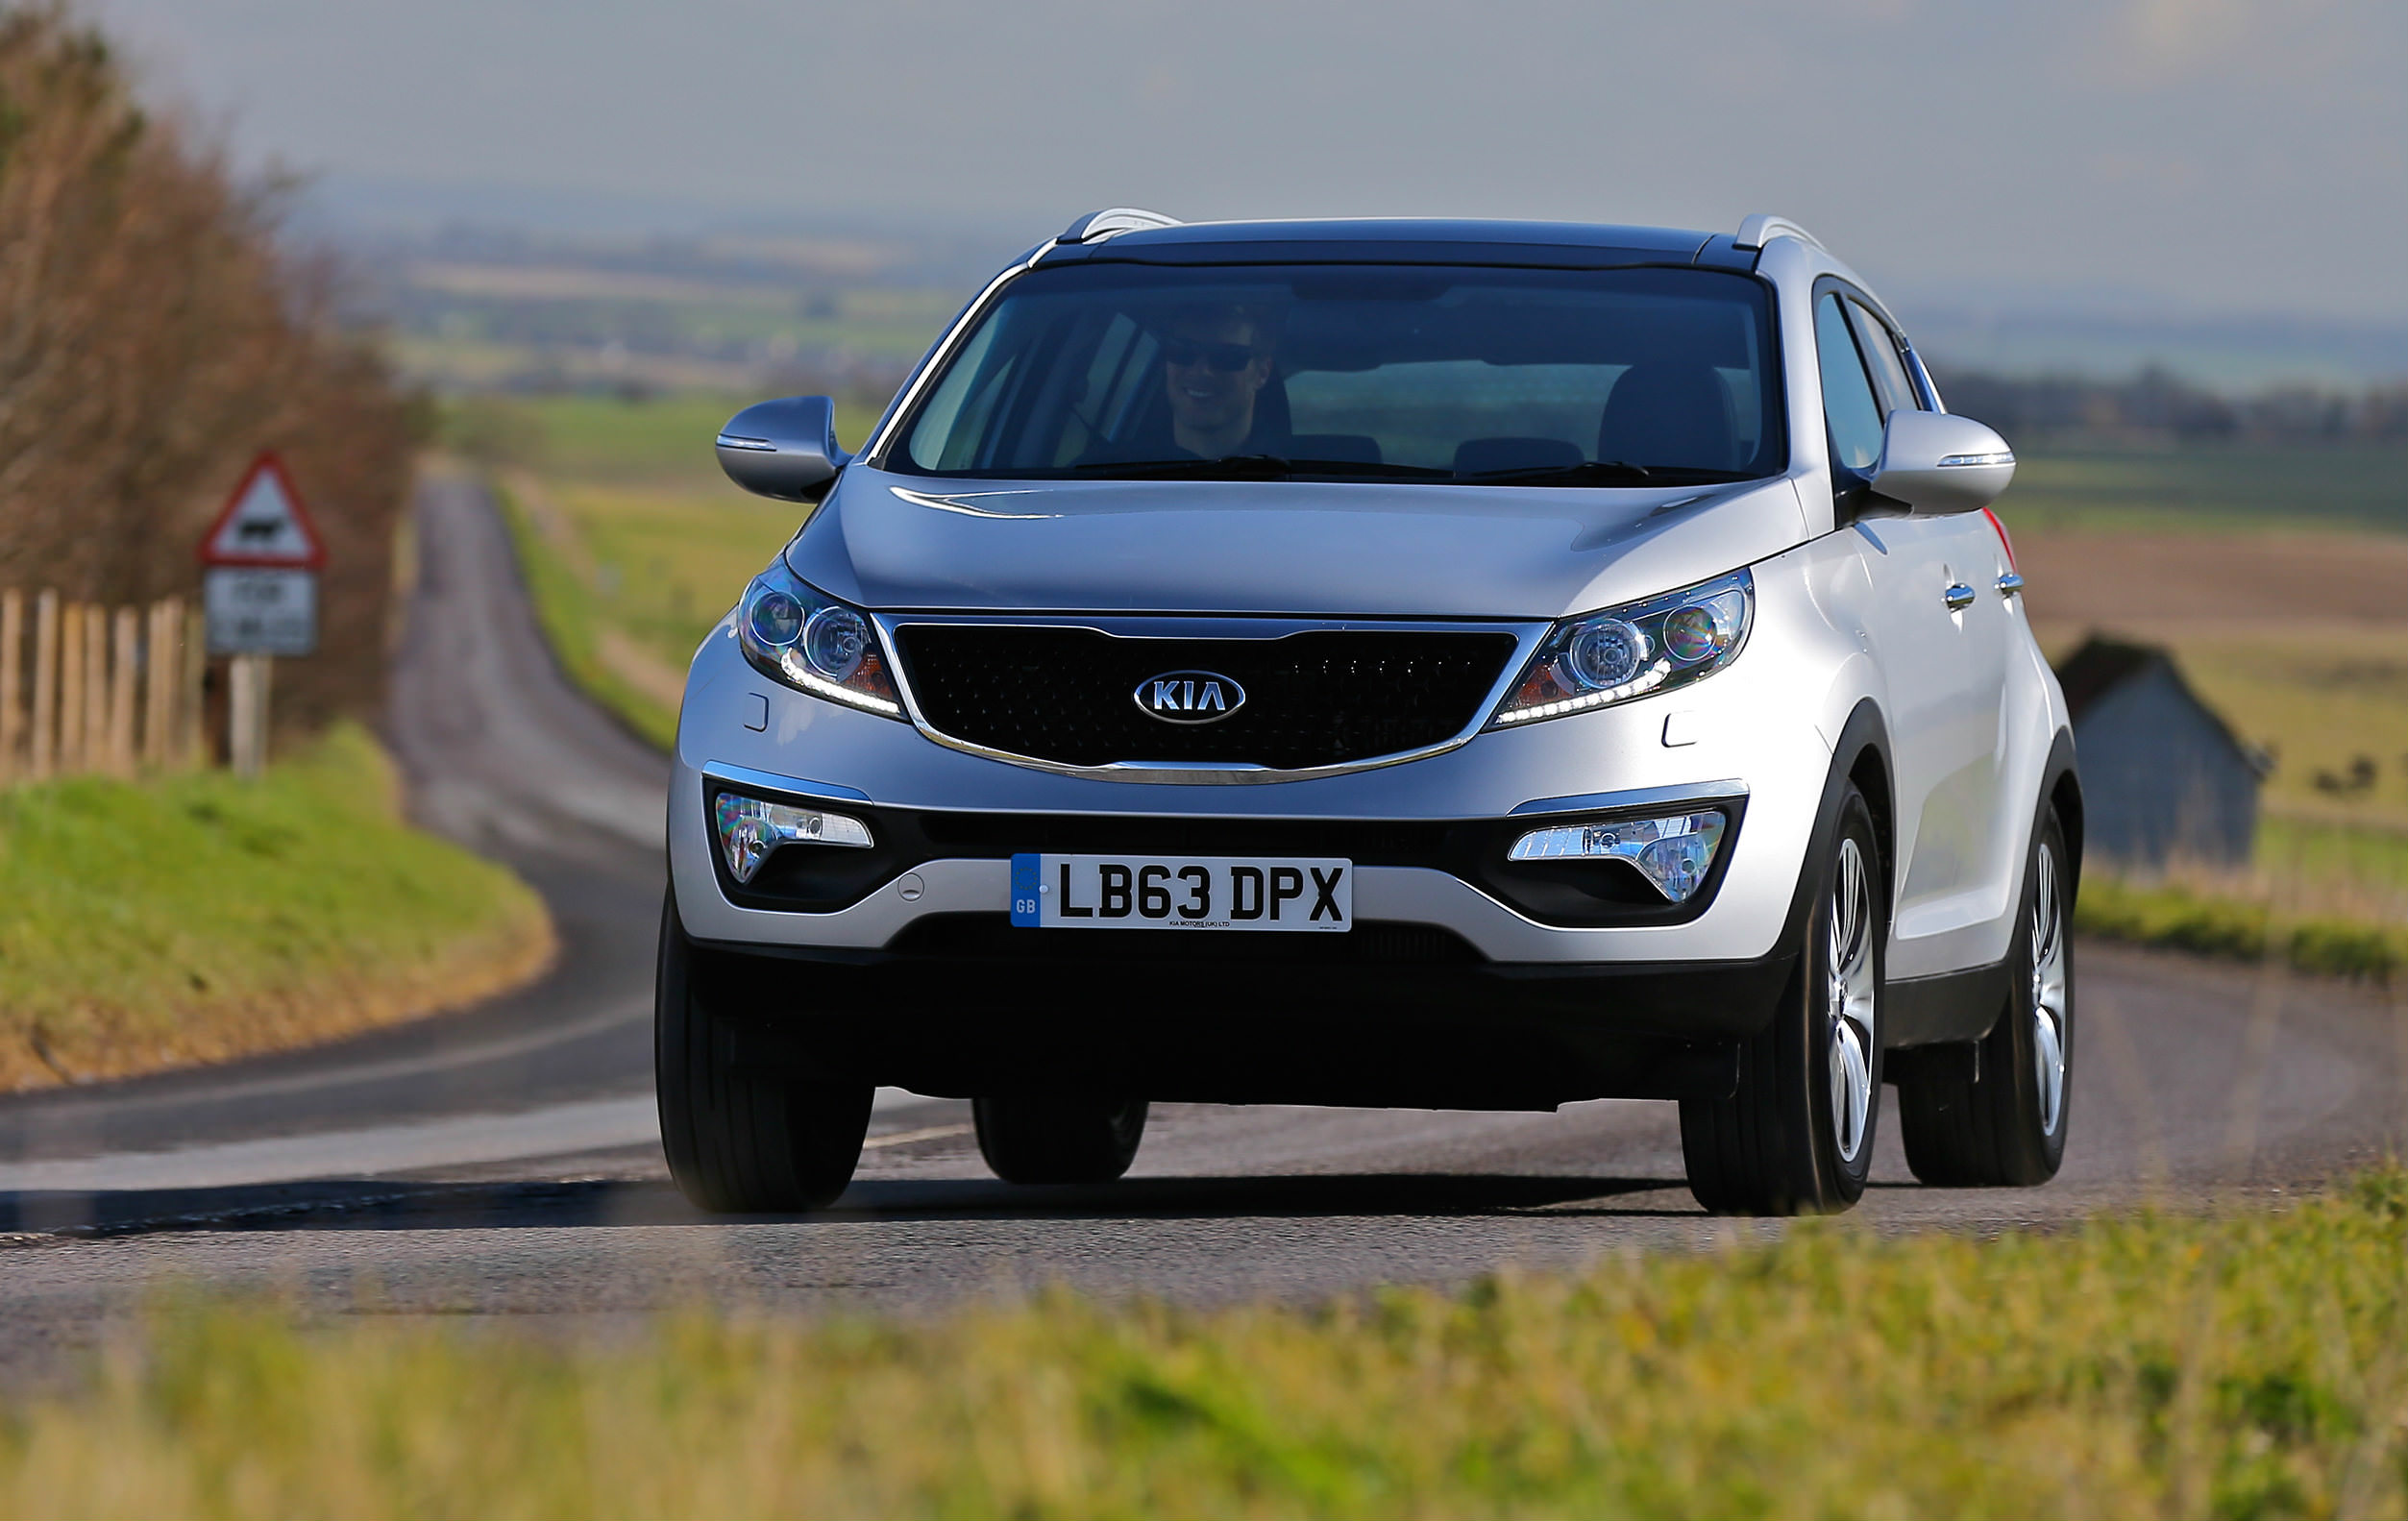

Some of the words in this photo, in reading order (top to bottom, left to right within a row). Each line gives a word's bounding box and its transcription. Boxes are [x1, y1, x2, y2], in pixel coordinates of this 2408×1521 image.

[1154, 681, 1225, 710] KIA
[1016, 899, 1036, 914] GB
[1060, 863, 1211, 919] LB63
[1230, 866, 1343, 921] DPX
